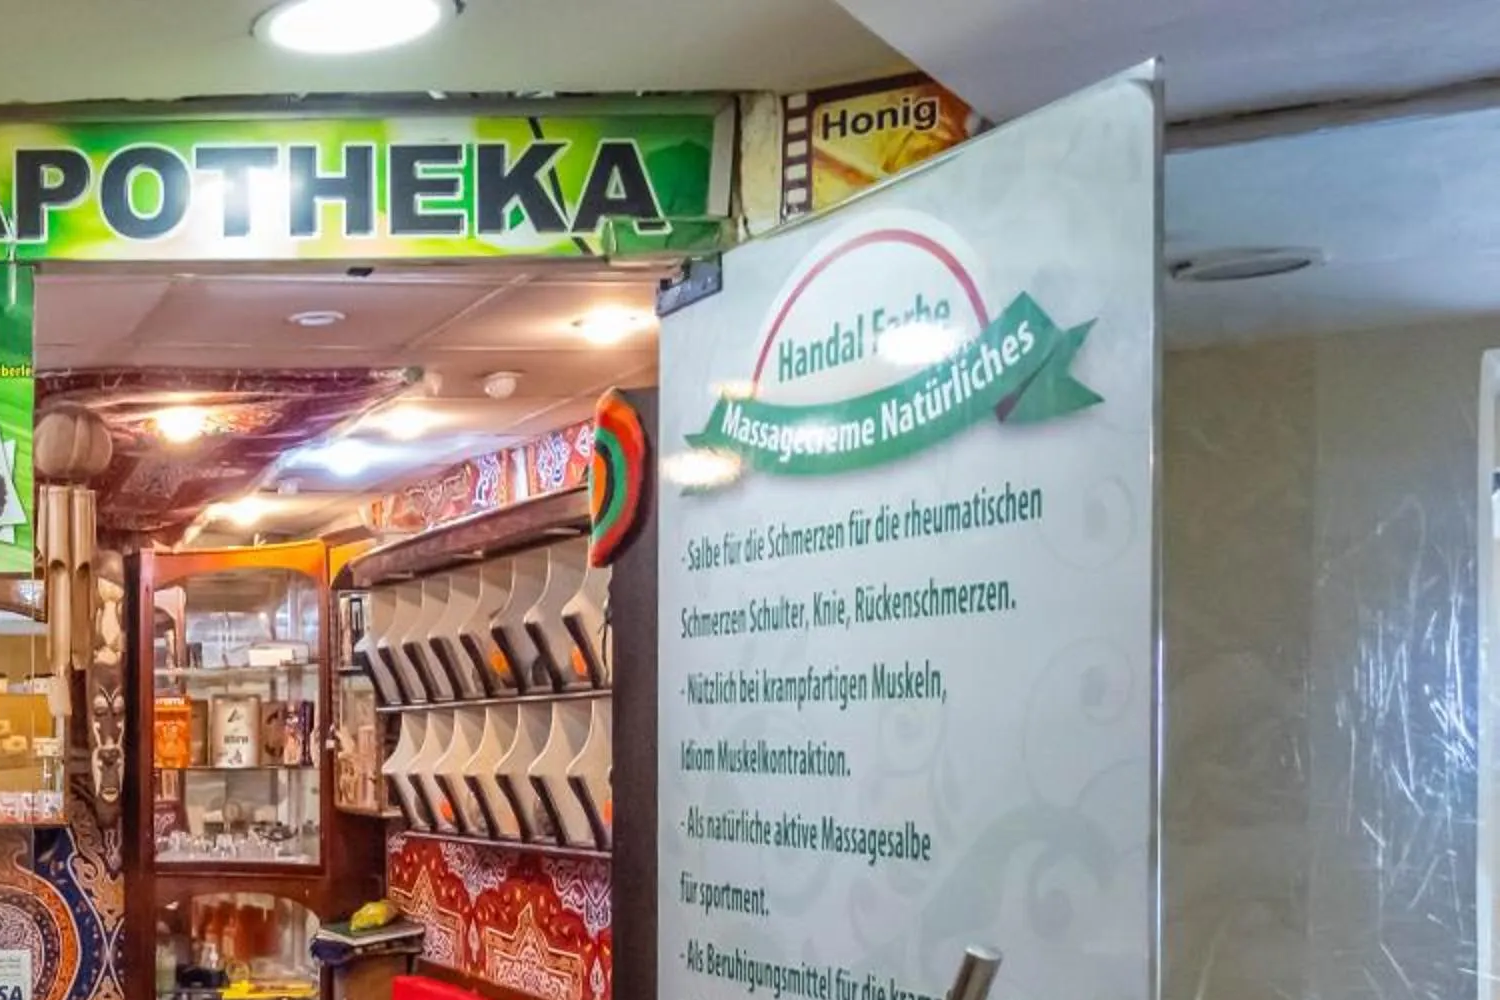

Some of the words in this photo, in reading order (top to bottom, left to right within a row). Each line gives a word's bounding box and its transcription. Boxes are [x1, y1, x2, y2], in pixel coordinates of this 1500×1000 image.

[822, 97, 937, 142] Honig
[779, 314, 864, 383] Handal
[881, 318, 1035, 442] Natürliches
[688, 536, 720, 571] Salbe
[722, 531, 742, 565] für
[744, 527, 765, 563] die
[767, 519, 845, 560] Schmerzen
[848, 508, 871, 547] für
[875, 502, 900, 543] die
[903, 481, 1043, 538] rheumatischen
[681, 603, 746, 639] Schmerzen
[749, 596, 809, 632] Schulter,
[812, 589, 851, 631] Knie,
[855, 577, 1016, 620] Rückenschmerzen.
[687, 668, 737, 706] Nützlich
[739, 667, 760, 702] bei
[762, 664, 867, 710] krampfartigen
[871, 660, 948, 706] Muskeln,
[681, 739, 715, 773] Idiom
[717, 738, 851, 778] Muskelkontraktion.
[687, 807, 704, 838] Als
[706, 811, 772, 847] natürliche
[774, 815, 818, 850] aktive
[820, 816, 932, 867] Massagesalbe
[680, 871, 698, 901] für
[699, 875, 769, 917] sportment.
[686, 939, 704, 973] Als
[706, 944, 833, 997] Beruhigungsmittel
